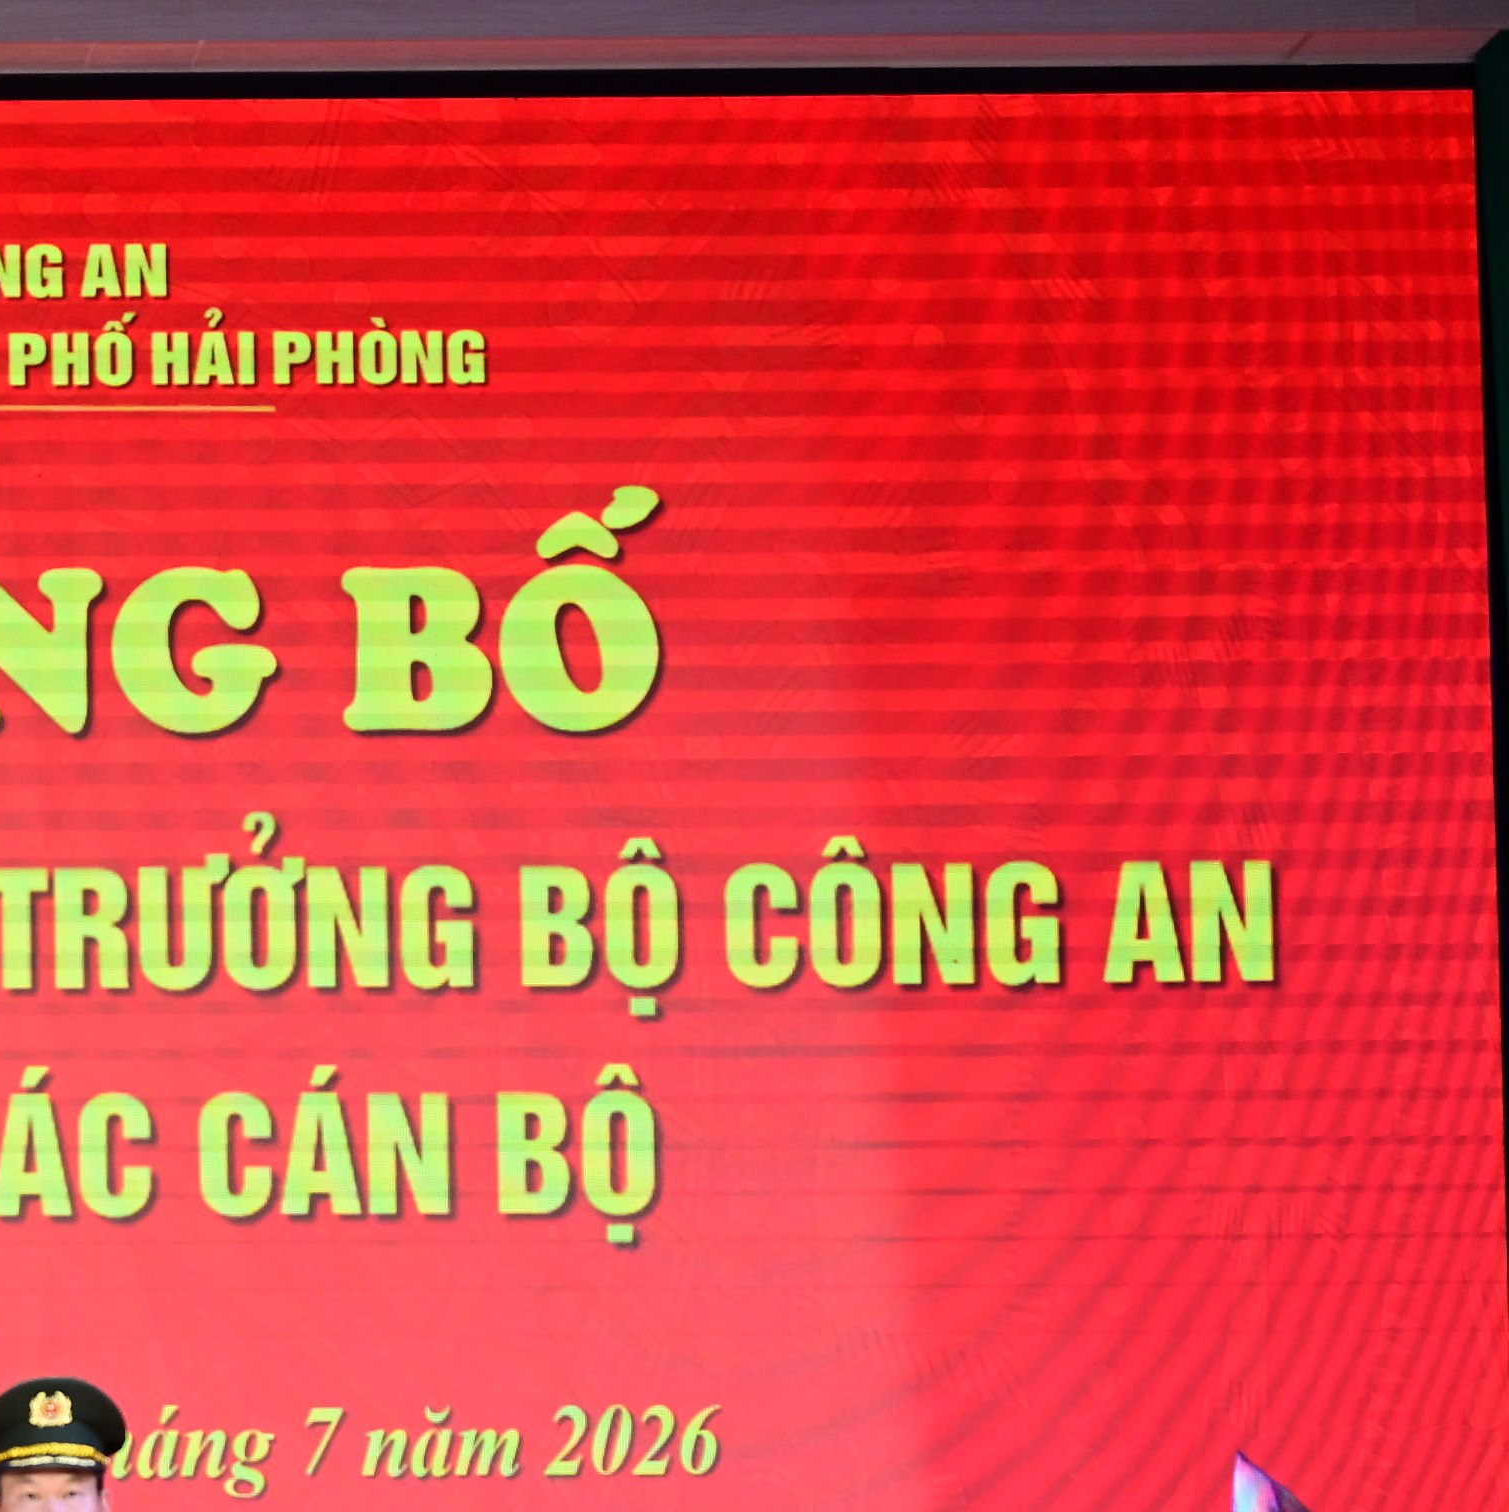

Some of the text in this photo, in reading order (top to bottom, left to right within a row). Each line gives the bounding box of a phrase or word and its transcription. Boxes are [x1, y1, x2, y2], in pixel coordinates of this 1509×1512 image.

[80, 243, 167, 297] AN
[8, 314, 135, 387] PHỐ
[151, 309, 255, 385] HẢI
[273, 317, 485, 385] PHÒNG
[341, 485, 660, 732] BỐ
[519, 836, 679, 1017] BỘ
[724, 835, 1060, 988] CÔNG
[1104, 860, 1274, 983] AN
[197, 1064, 451, 1217] CÁN
[496, 1062, 656, 1244] BỘ
[305, 1407, 344, 1476] 7
[362, 1405, 521, 1478] năm
[544, 1404, 721, 1476] 2026
